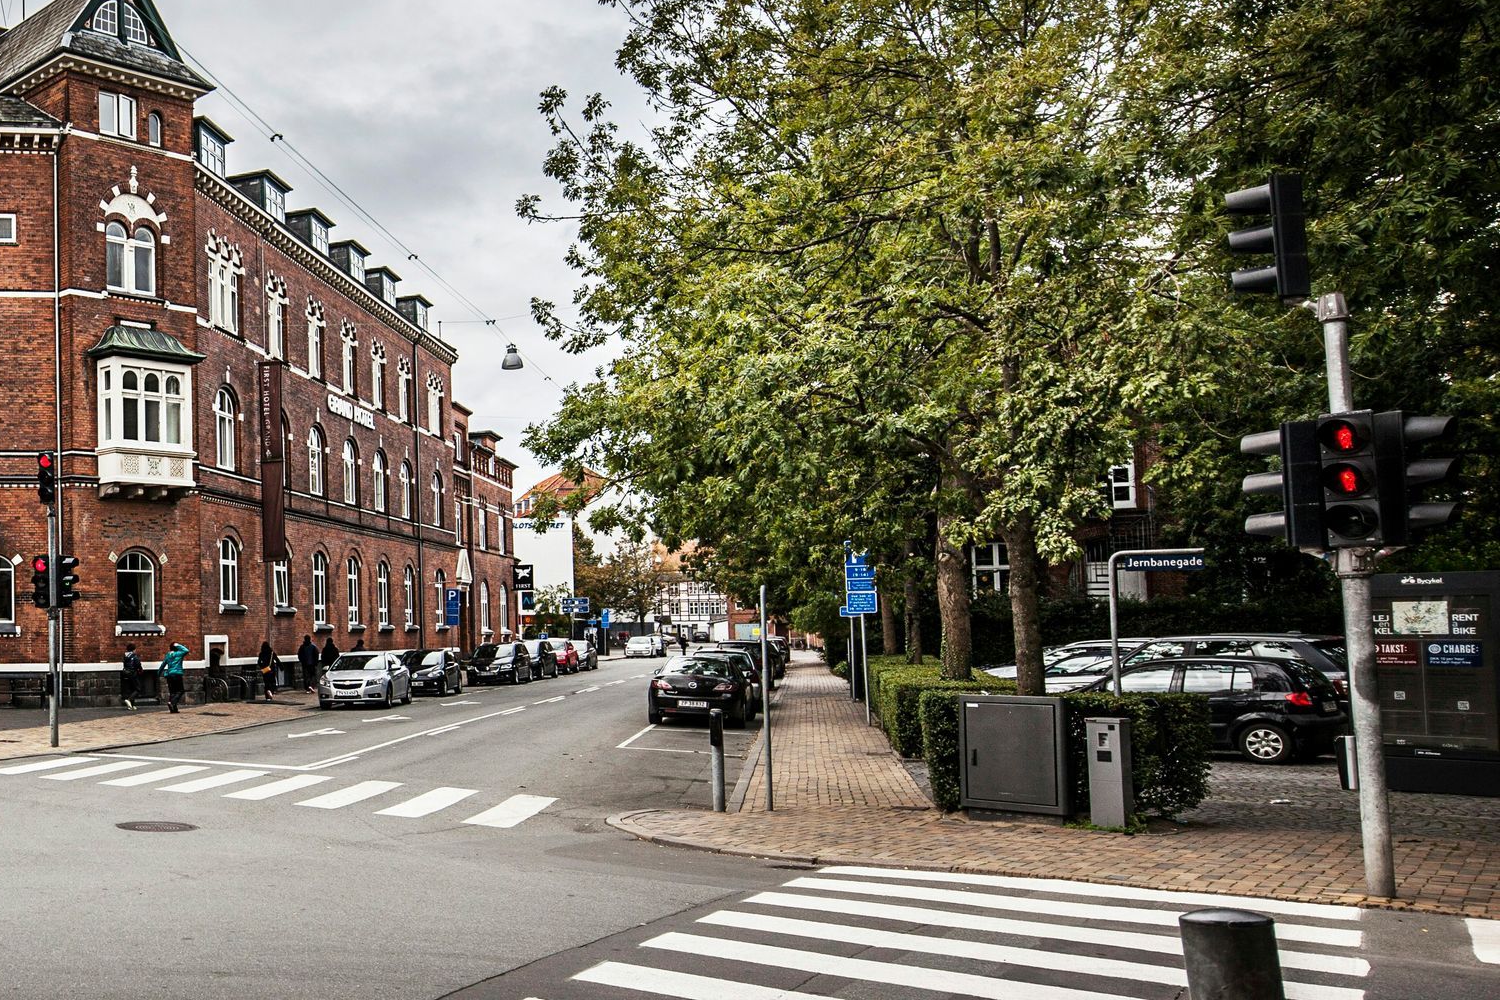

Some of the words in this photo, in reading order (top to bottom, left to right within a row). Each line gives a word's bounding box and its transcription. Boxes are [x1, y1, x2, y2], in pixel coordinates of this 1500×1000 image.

[263, 365, 271, 388] FIRST
[263, 390, 271, 416] HOTEL
[327, 393, 353, 421] GRAND
[353, 405, 376, 430] HOTEL
[1127, 556, 1203, 569] Jernbanegade
[1372, 614, 1390, 622] LEJ
[1451, 613, 1480, 622] RENT
[1452, 627, 1477, 635] BIKE
[1381, 644, 1408, 653] TAKST:
[1443, 644, 1479, 654] CHARGE:
